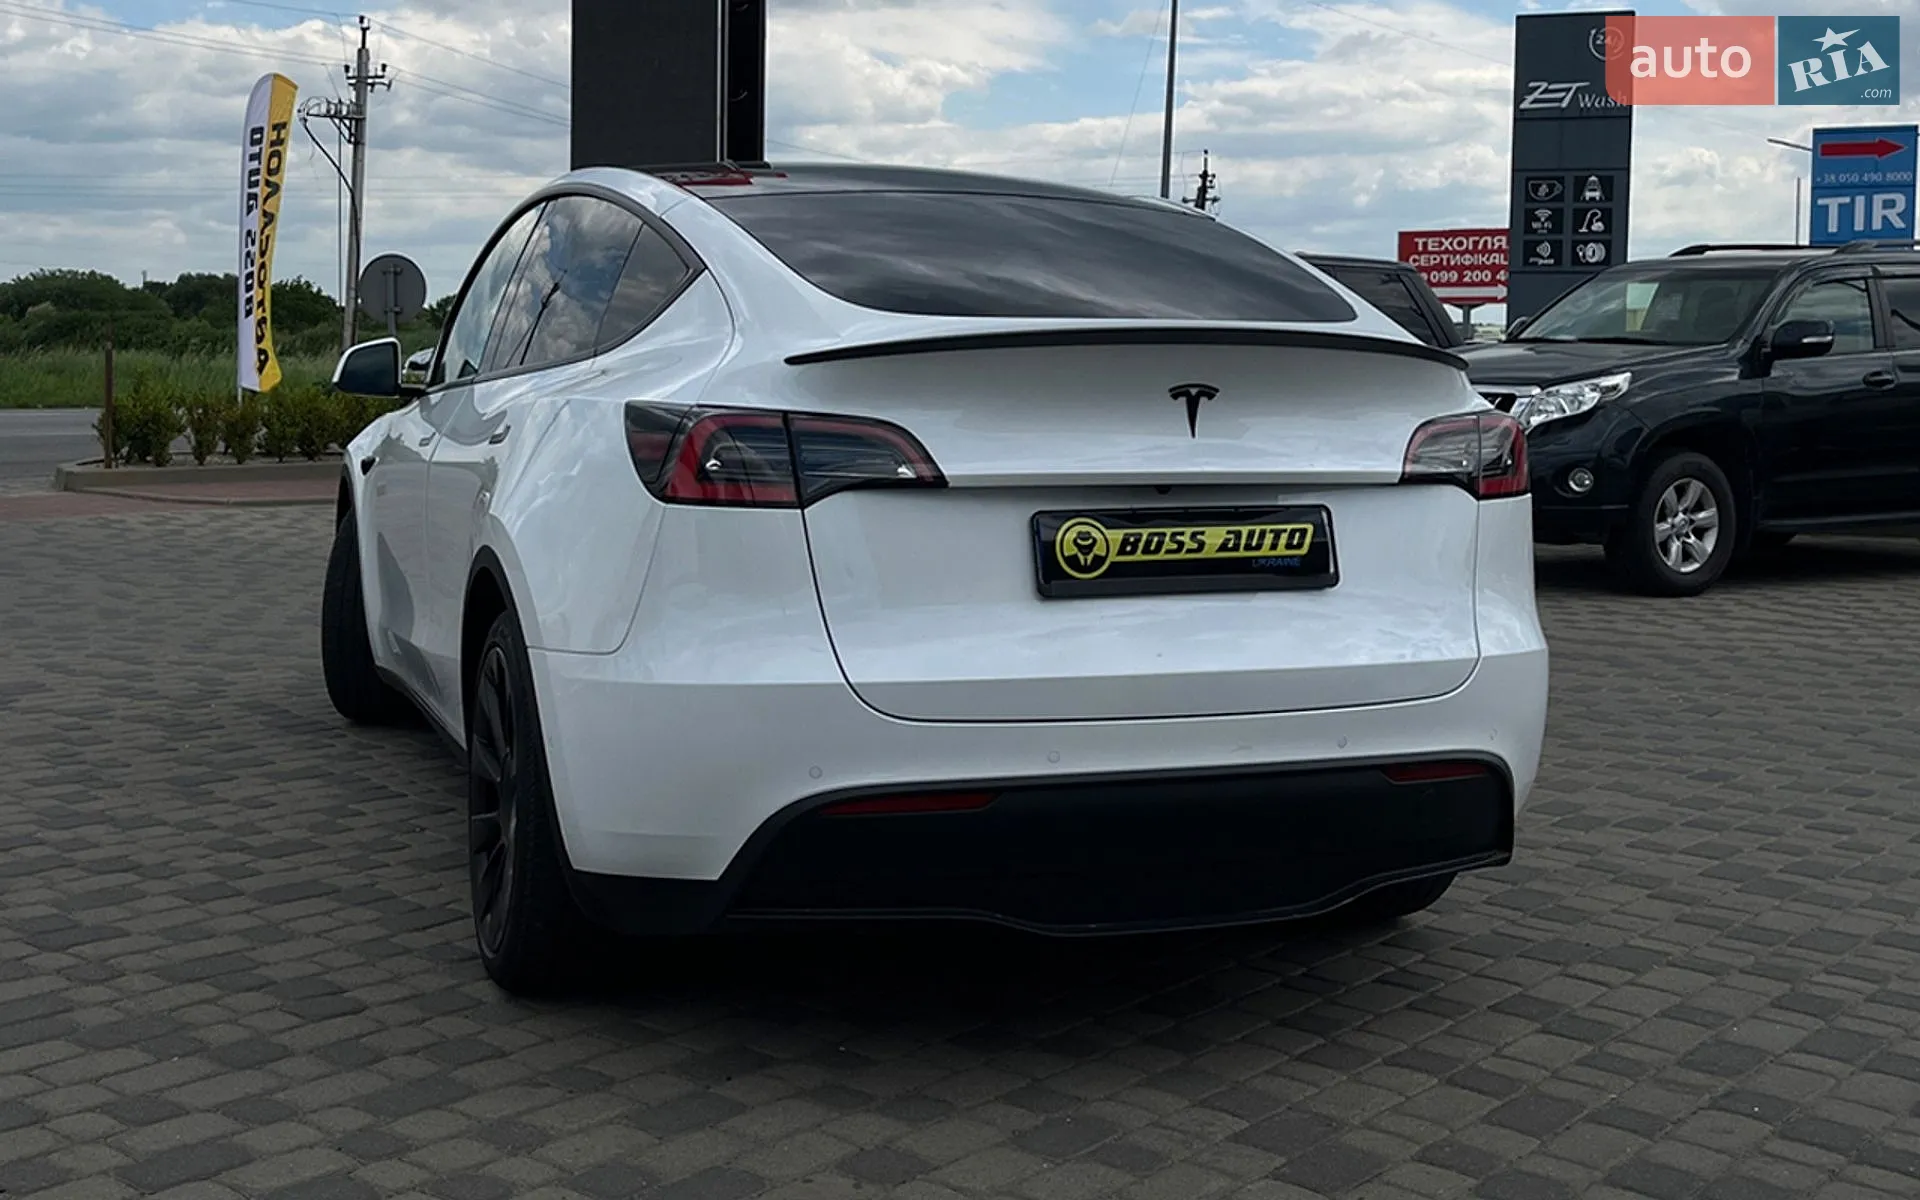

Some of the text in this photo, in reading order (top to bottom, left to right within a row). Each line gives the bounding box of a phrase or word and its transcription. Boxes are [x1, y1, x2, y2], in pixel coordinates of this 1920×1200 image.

[1816, 192, 1907, 234] TIR
[1414, 235, 1510, 251] ТЕХОГЛЯ
[1430, 268, 1510, 283] 099 200 4
[1115, 527, 1308, 556] BOSS AUTO
